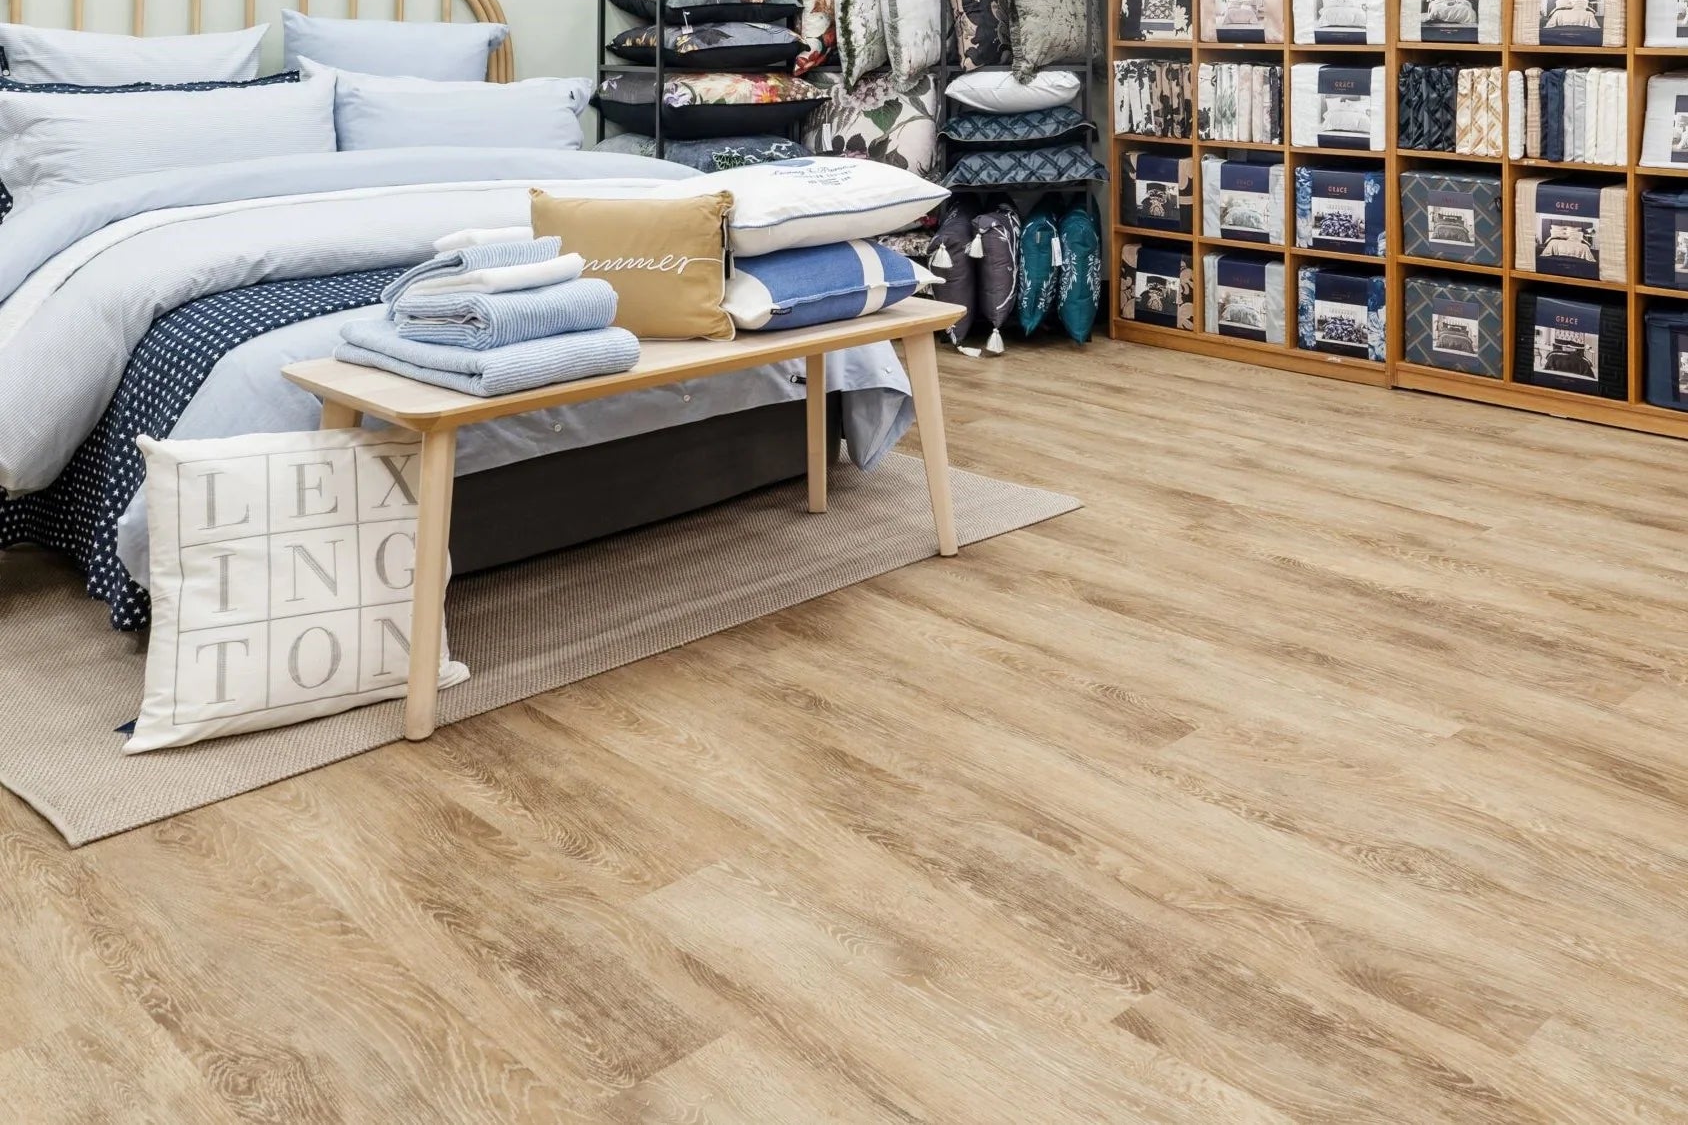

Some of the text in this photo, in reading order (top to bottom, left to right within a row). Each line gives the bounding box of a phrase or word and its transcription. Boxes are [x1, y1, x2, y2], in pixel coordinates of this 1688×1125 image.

[1328, 186, 1347, 194] GRACE
[1556, 202, 1579, 211] GRACE
[582, 254, 693, 275] mmer
[1556, 316, 1578, 325] GRACE
[197, 453, 418, 530] LEX
